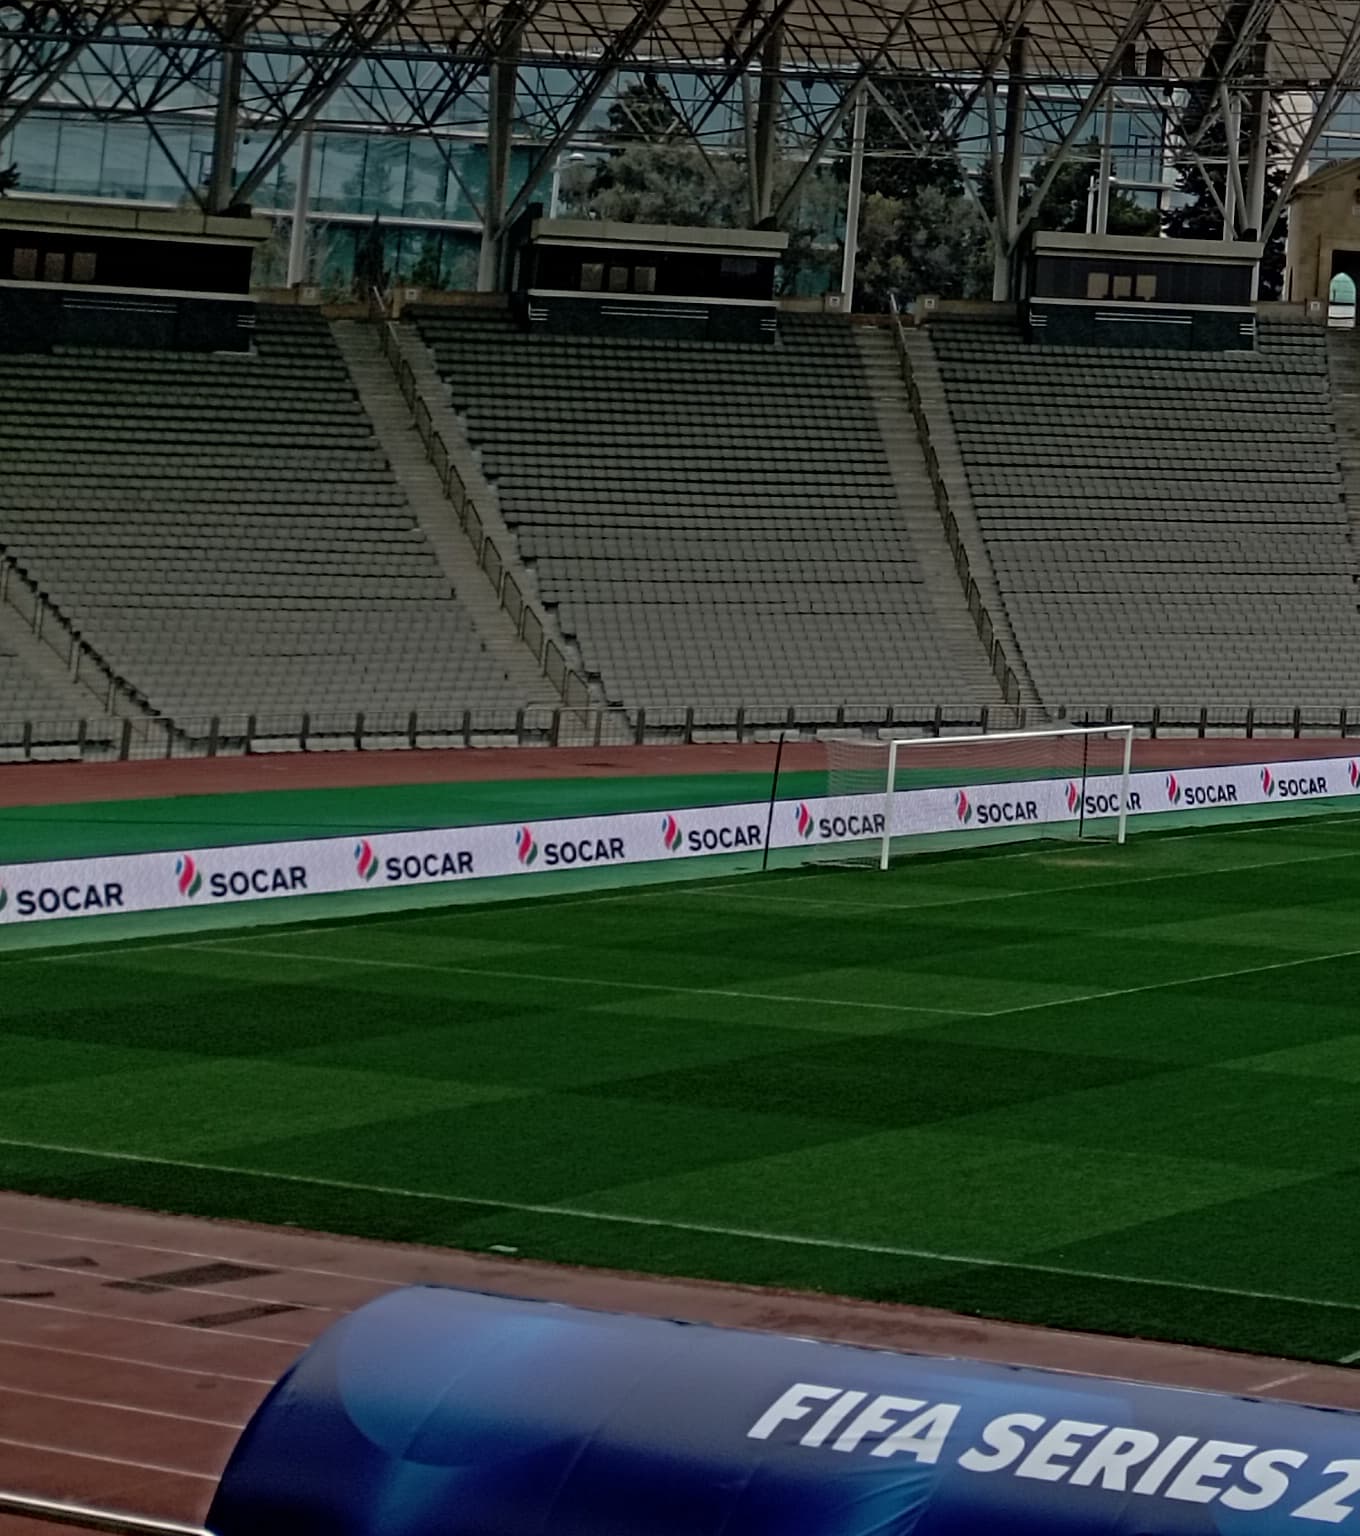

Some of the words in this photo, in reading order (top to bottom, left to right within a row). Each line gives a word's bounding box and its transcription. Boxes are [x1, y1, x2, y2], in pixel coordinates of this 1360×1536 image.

[1185, 785, 1237, 805] SOCAR
[1279, 777, 1327, 796] SOCAR
[977, 801, 1037, 823] SOCAR
[689, 825, 761, 851] SOCAR
[820, 814, 885, 838] SOCAR
[545, 838, 624, 865] SOCAR
[386, 852, 473, 880] SOCAR
[211, 867, 307, 897] SOCAR
[17, 883, 123, 915] SOCAR
[747, 1383, 961, 1464] FIFA
[958, 1413, 1309, 1511] SERIES
